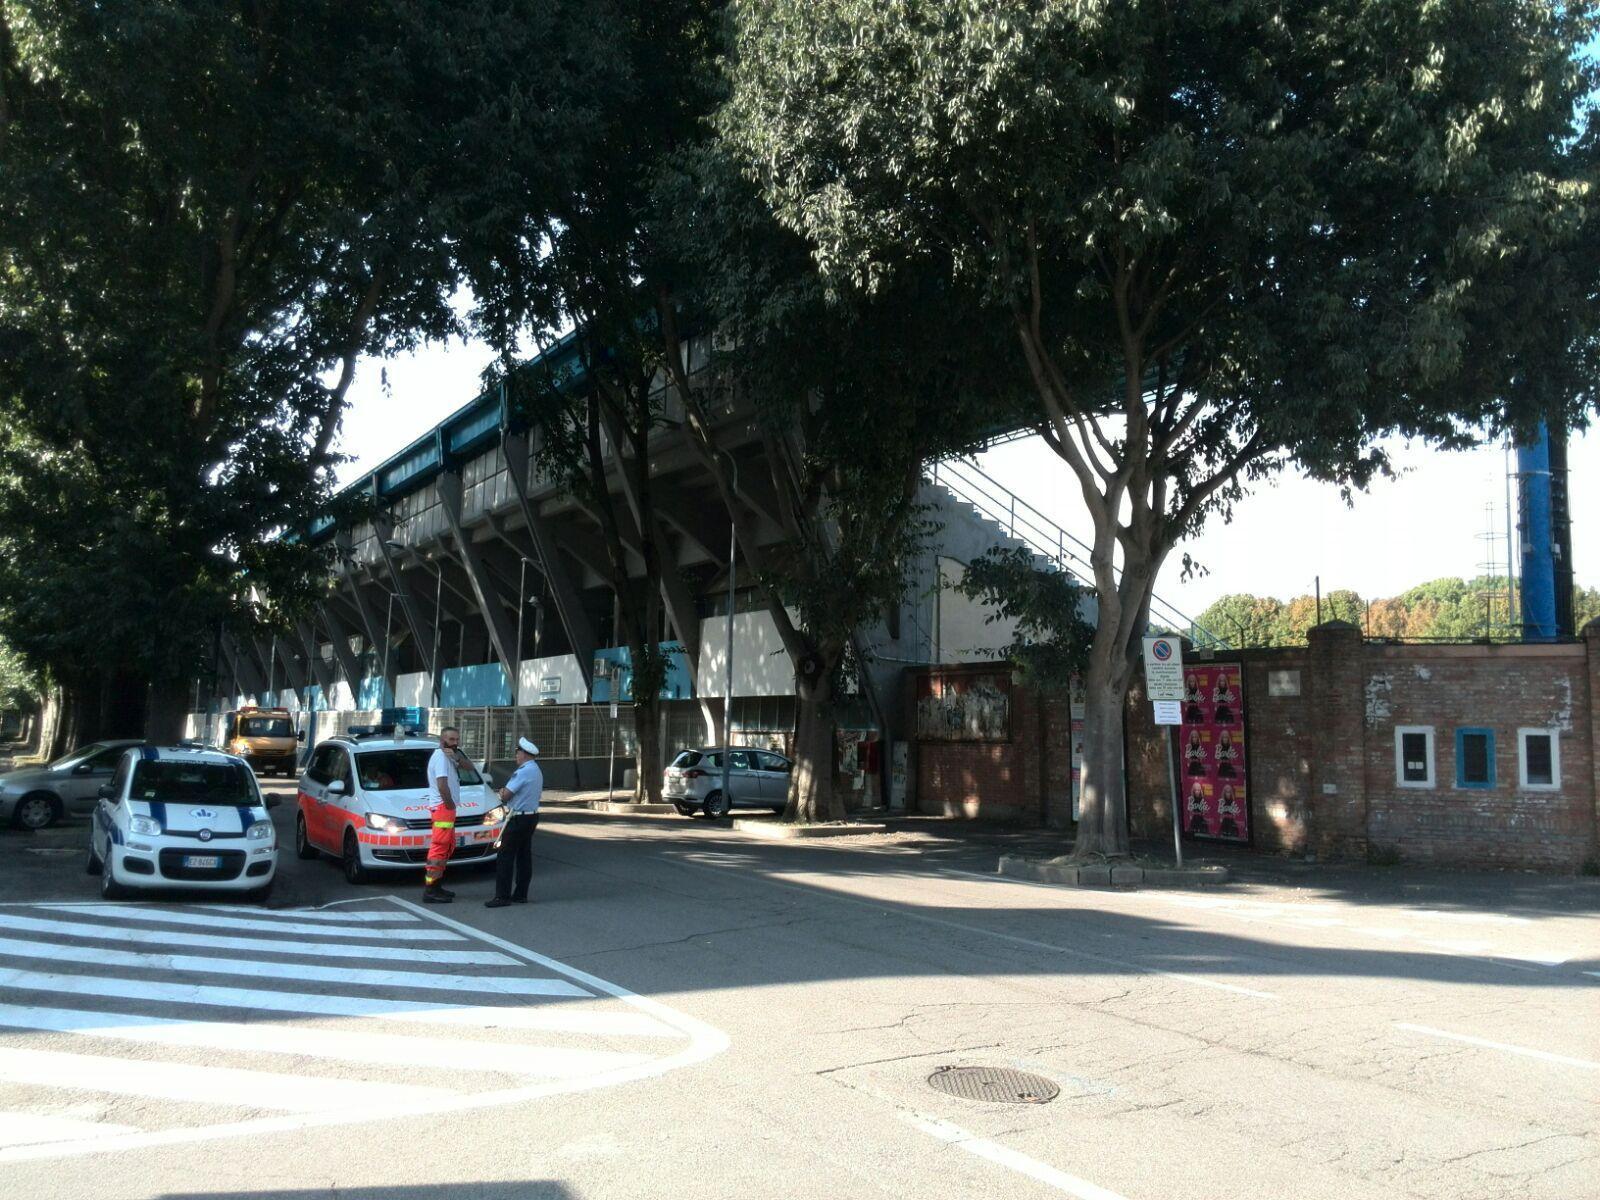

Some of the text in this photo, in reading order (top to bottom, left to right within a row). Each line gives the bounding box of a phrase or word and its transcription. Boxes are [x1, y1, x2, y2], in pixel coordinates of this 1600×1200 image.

[1185, 744, 1208, 760] Barbie
[1215, 744, 1239, 760] Barbie
[1187, 796, 1211, 813] Barbie
[1217, 798, 1241, 815] Barbie
